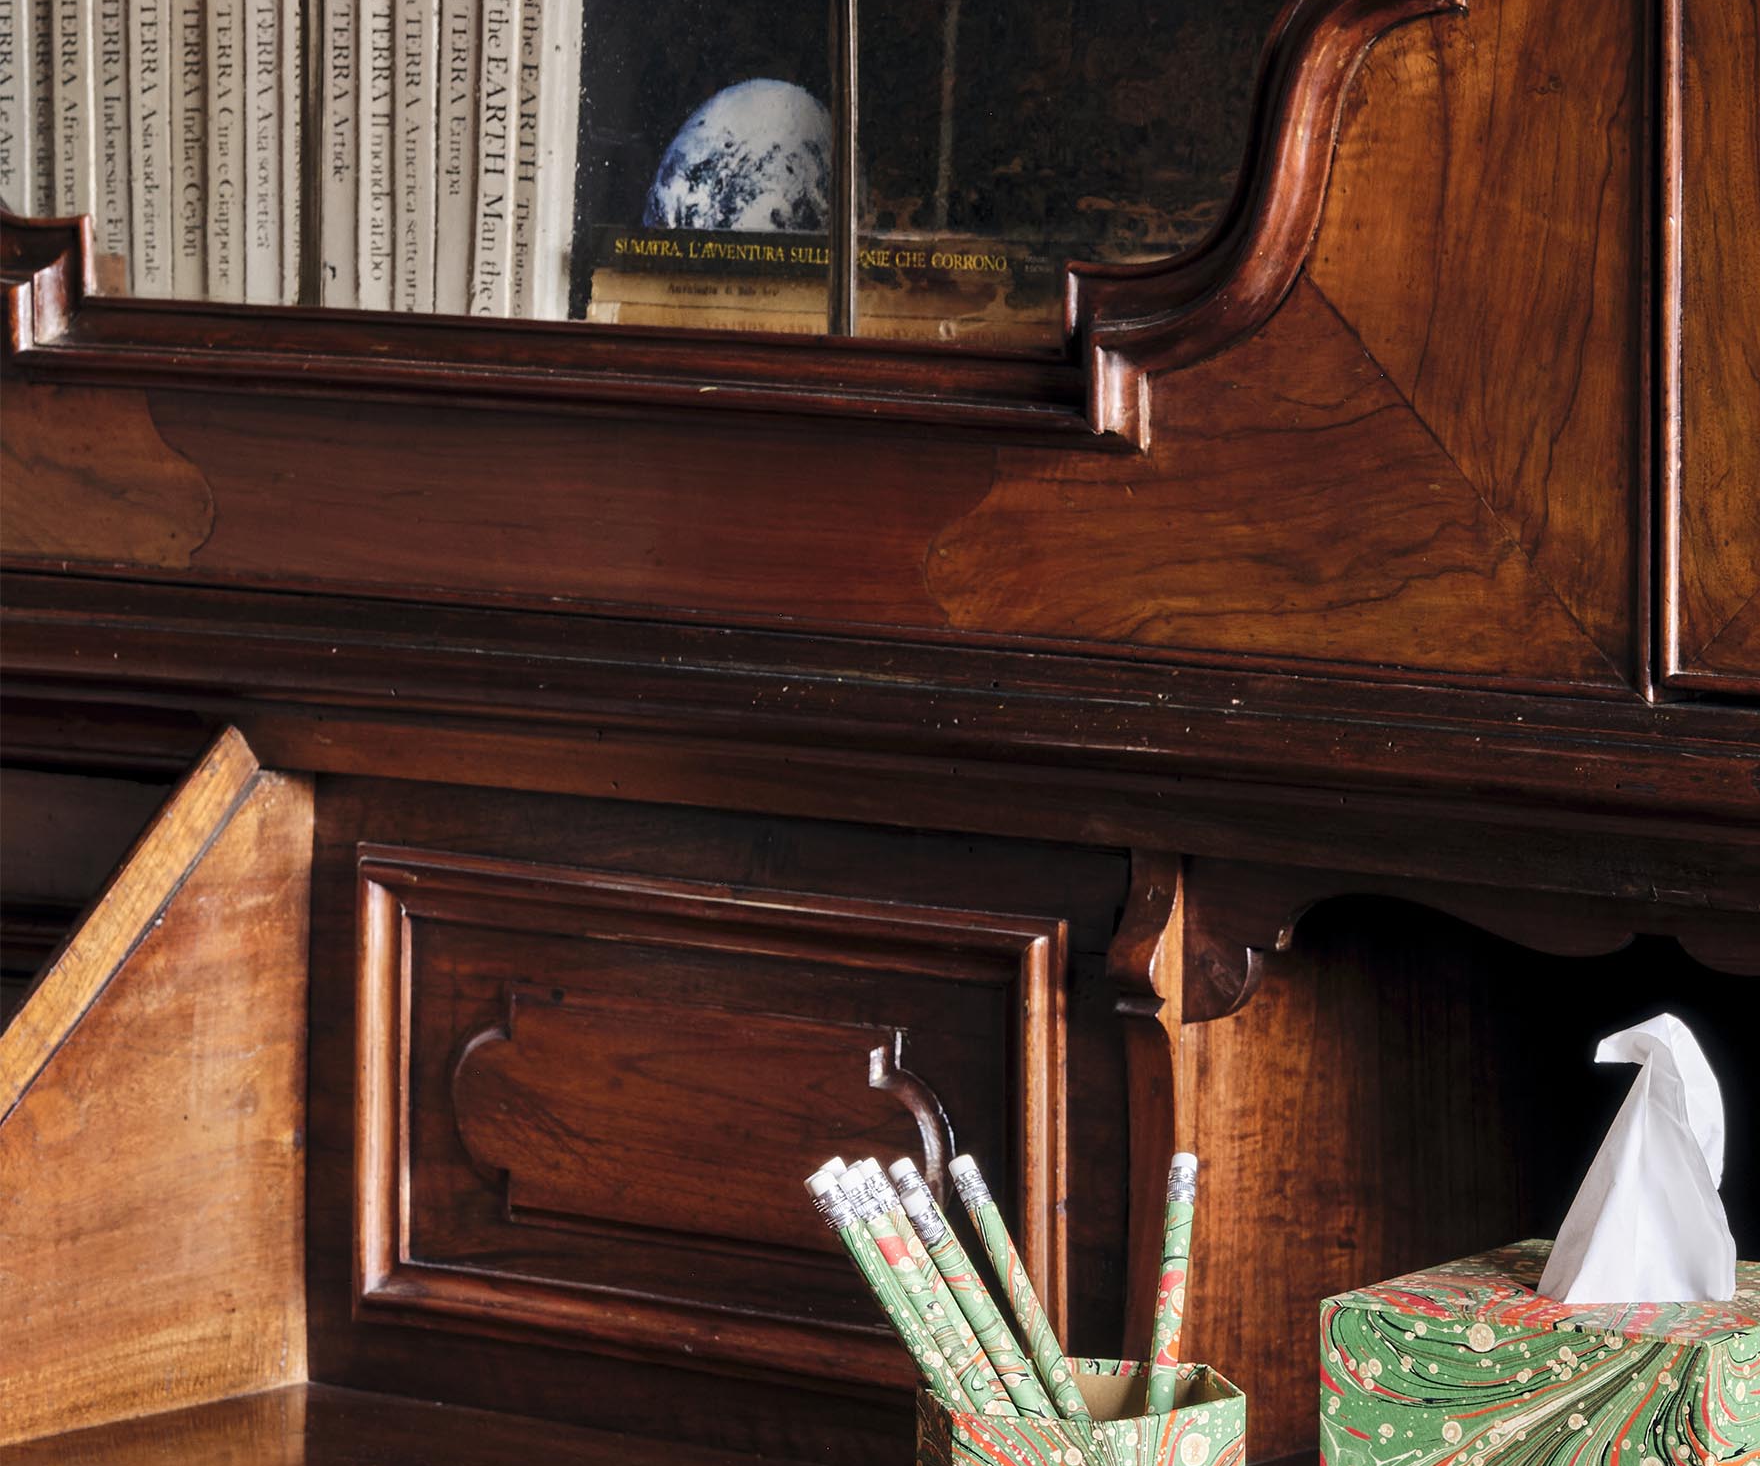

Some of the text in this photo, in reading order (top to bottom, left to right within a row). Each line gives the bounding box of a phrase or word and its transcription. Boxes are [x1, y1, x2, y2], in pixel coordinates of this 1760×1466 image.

[486, 7, 508, 50] the
[520, 13, 542, 56] the
[483, 54, 508, 177] EARTH
[517, 62, 540, 183] EARTH
[480, 191, 503, 252] Man
[895, 251, 926, 269] CHE
[930, 252, 1008, 272] CORRONO
